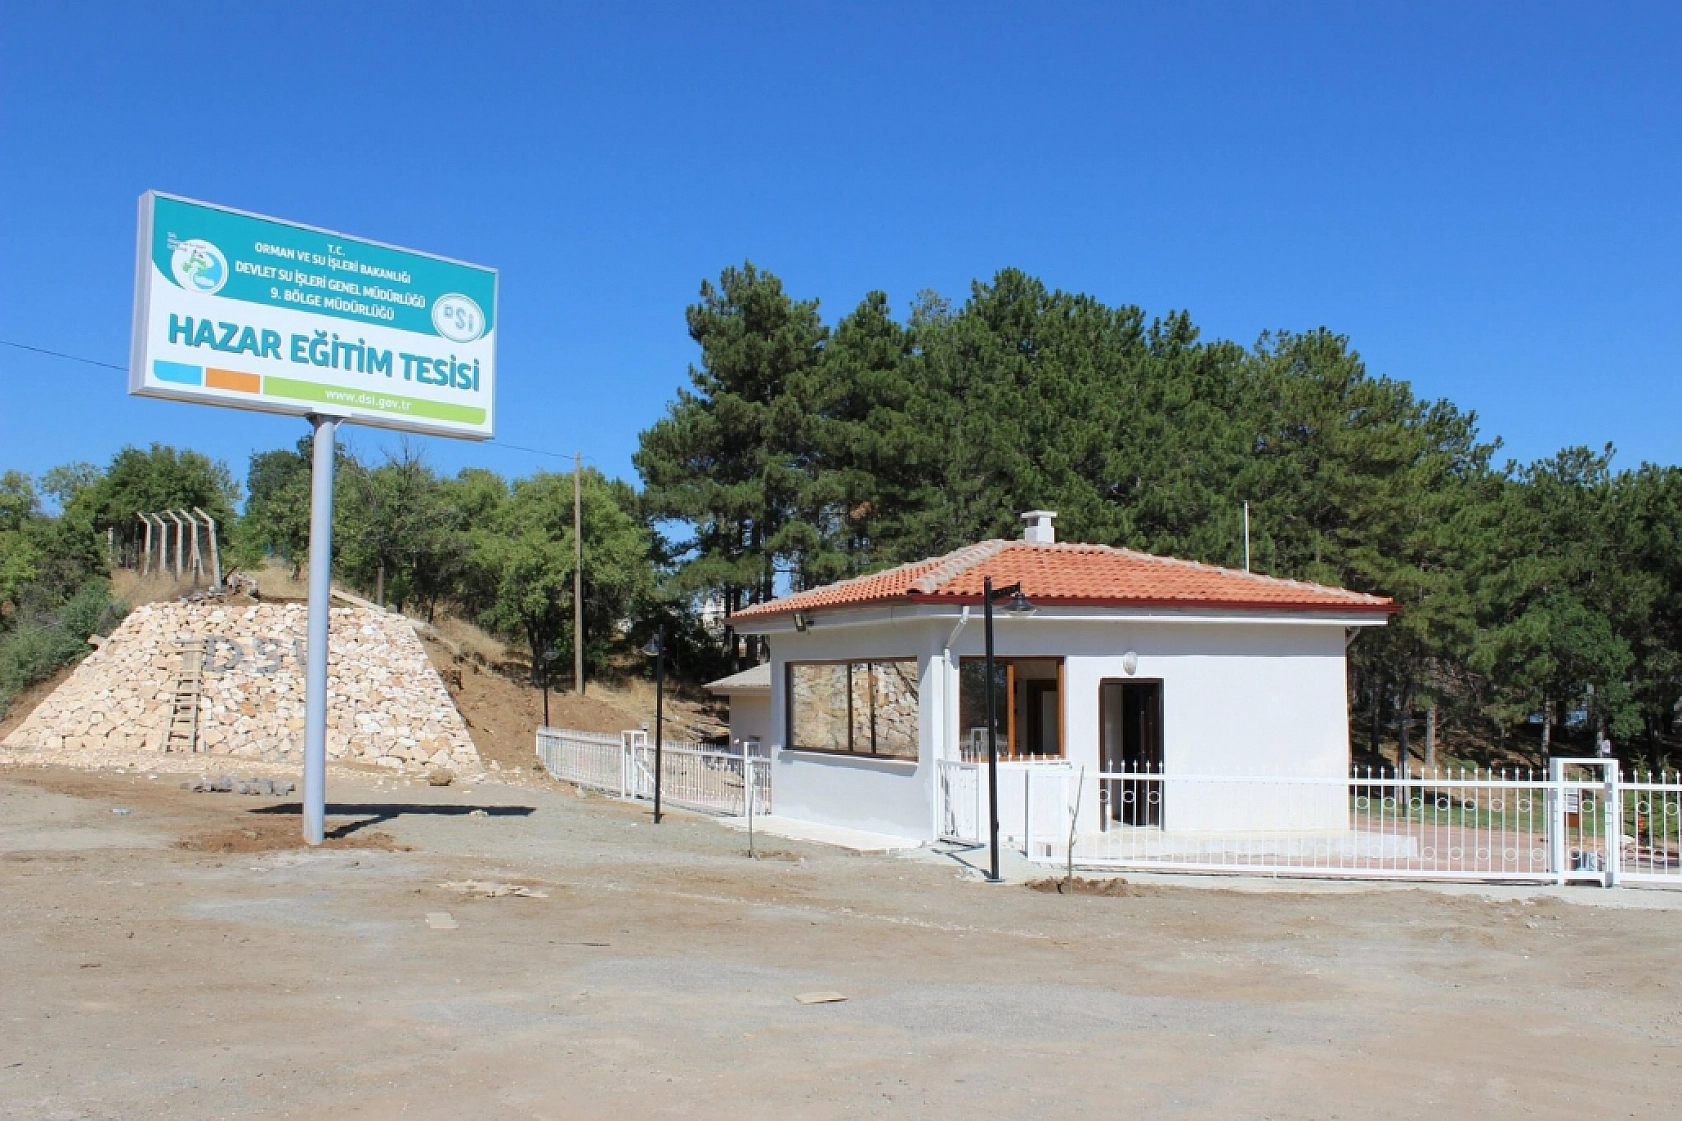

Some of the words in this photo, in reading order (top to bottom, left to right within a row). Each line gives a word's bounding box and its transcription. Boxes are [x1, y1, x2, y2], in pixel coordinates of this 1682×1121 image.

[254, 242, 295, 260] ORMAN
[297, 250, 311, 263] VE
[312, 255, 326, 266] SU
[328, 255, 359, 273] İŞLERİ
[360, 264, 411, 284] BAKANLIĞI
[327, 244, 345, 256] T.C.
[235, 260, 277, 279] DEVLET
[278, 269, 293, 282] SU
[295, 269, 326, 289] İŞLERİ
[328, 279, 361, 297] GENEL
[363, 286, 426, 309] MÜDÜRLÜĞÜ
[271, 287, 281, 300] 9.
[284, 288, 322, 307] BÖLGE
[323, 296, 395, 321] MÜDÜRLÜĞÜ
[168, 313, 283, 360] HAZAR
[290, 329, 393, 378] EĞİTİM
[399, 354, 480, 392] TESİSİ
[325, 389, 412, 411] www.dsi.gov.tr
